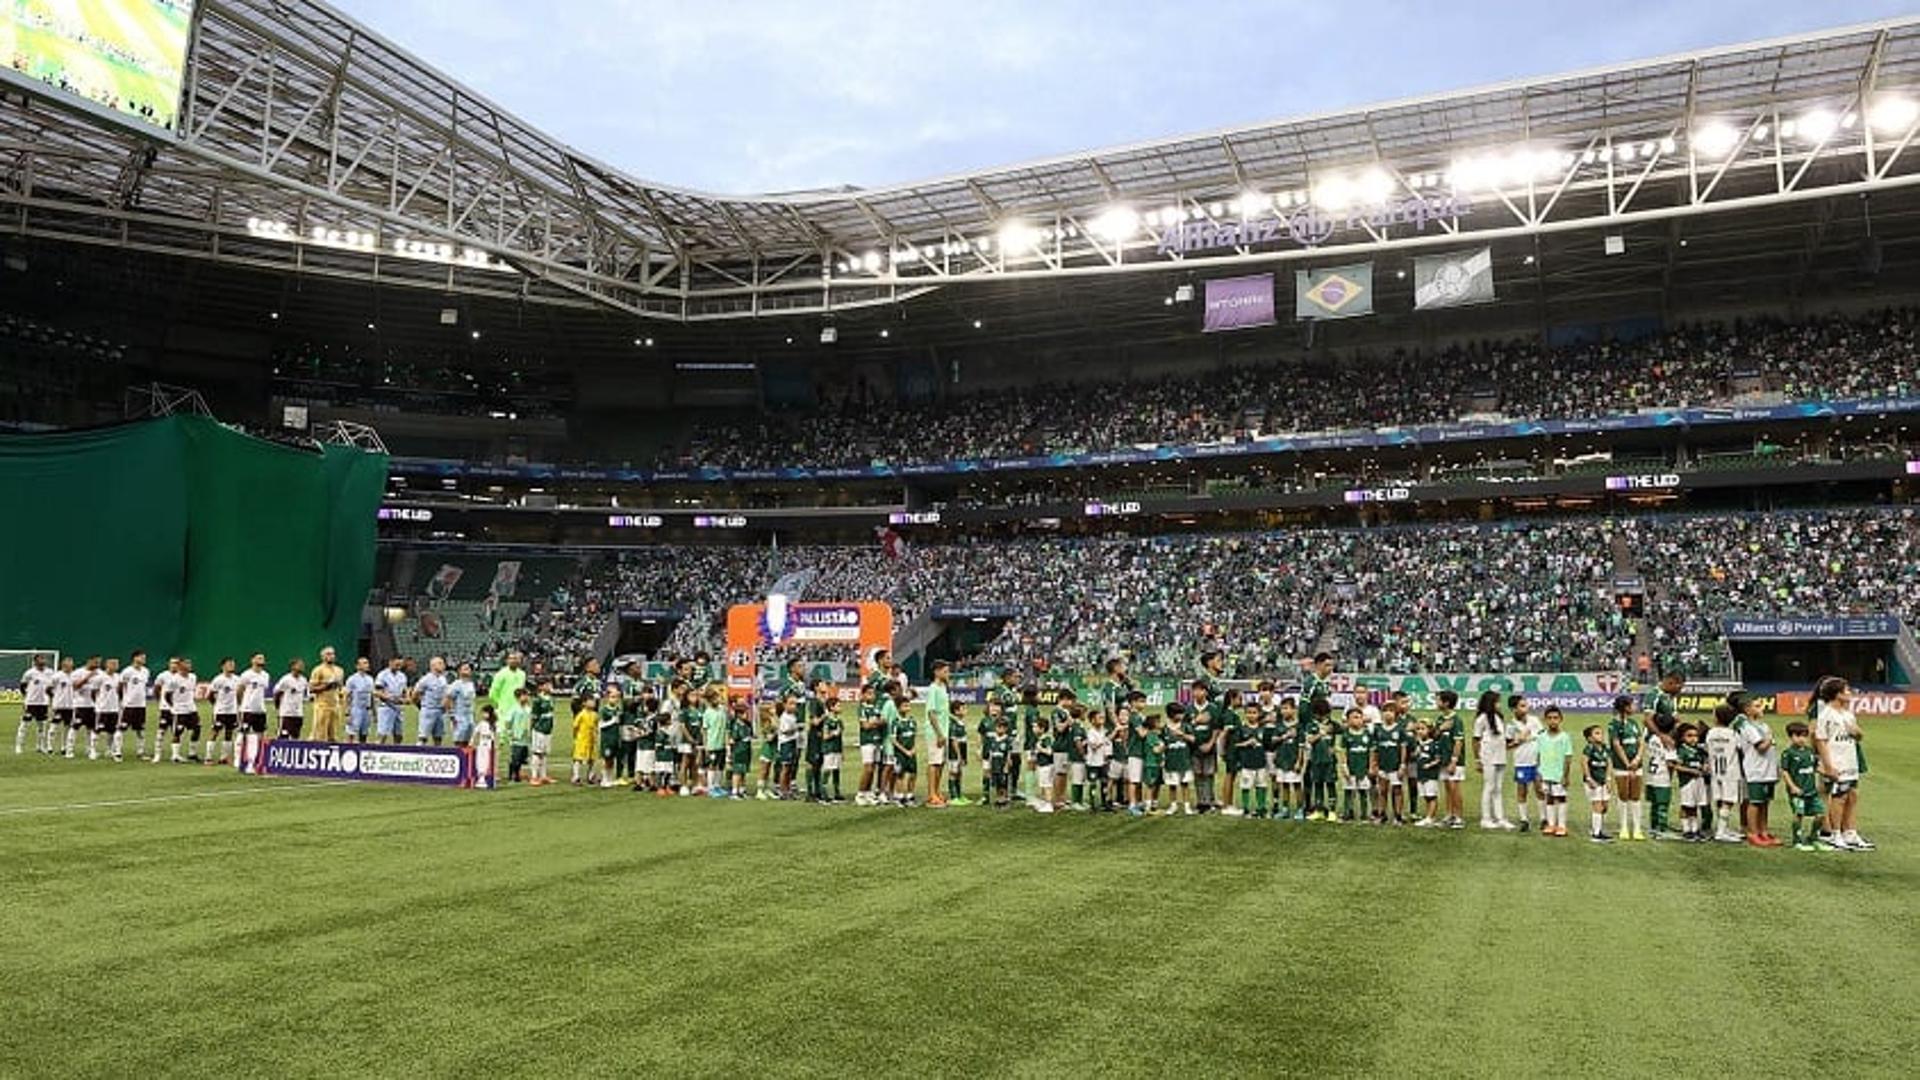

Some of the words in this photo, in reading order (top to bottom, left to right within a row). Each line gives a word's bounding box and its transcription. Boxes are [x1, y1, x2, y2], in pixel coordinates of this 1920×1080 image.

[1627, 475, 1651, 488] THE
[1653, 474, 1680, 487] LED
[1387, 488, 1409, 499] LED
[1120, 501, 1141, 513] LED
[1732, 621, 1775, 634] Allianz
[1794, 621, 1835, 635] Parque
[838, 688, 862, 701] BET
[1526, 696, 1578, 709] sportes
[1847, 696, 1906, 714] TANO
[268, 745, 359, 773] PAULISTÃO
[377, 756, 423, 773] Sicredi
[424, 757, 457, 774] 2023
